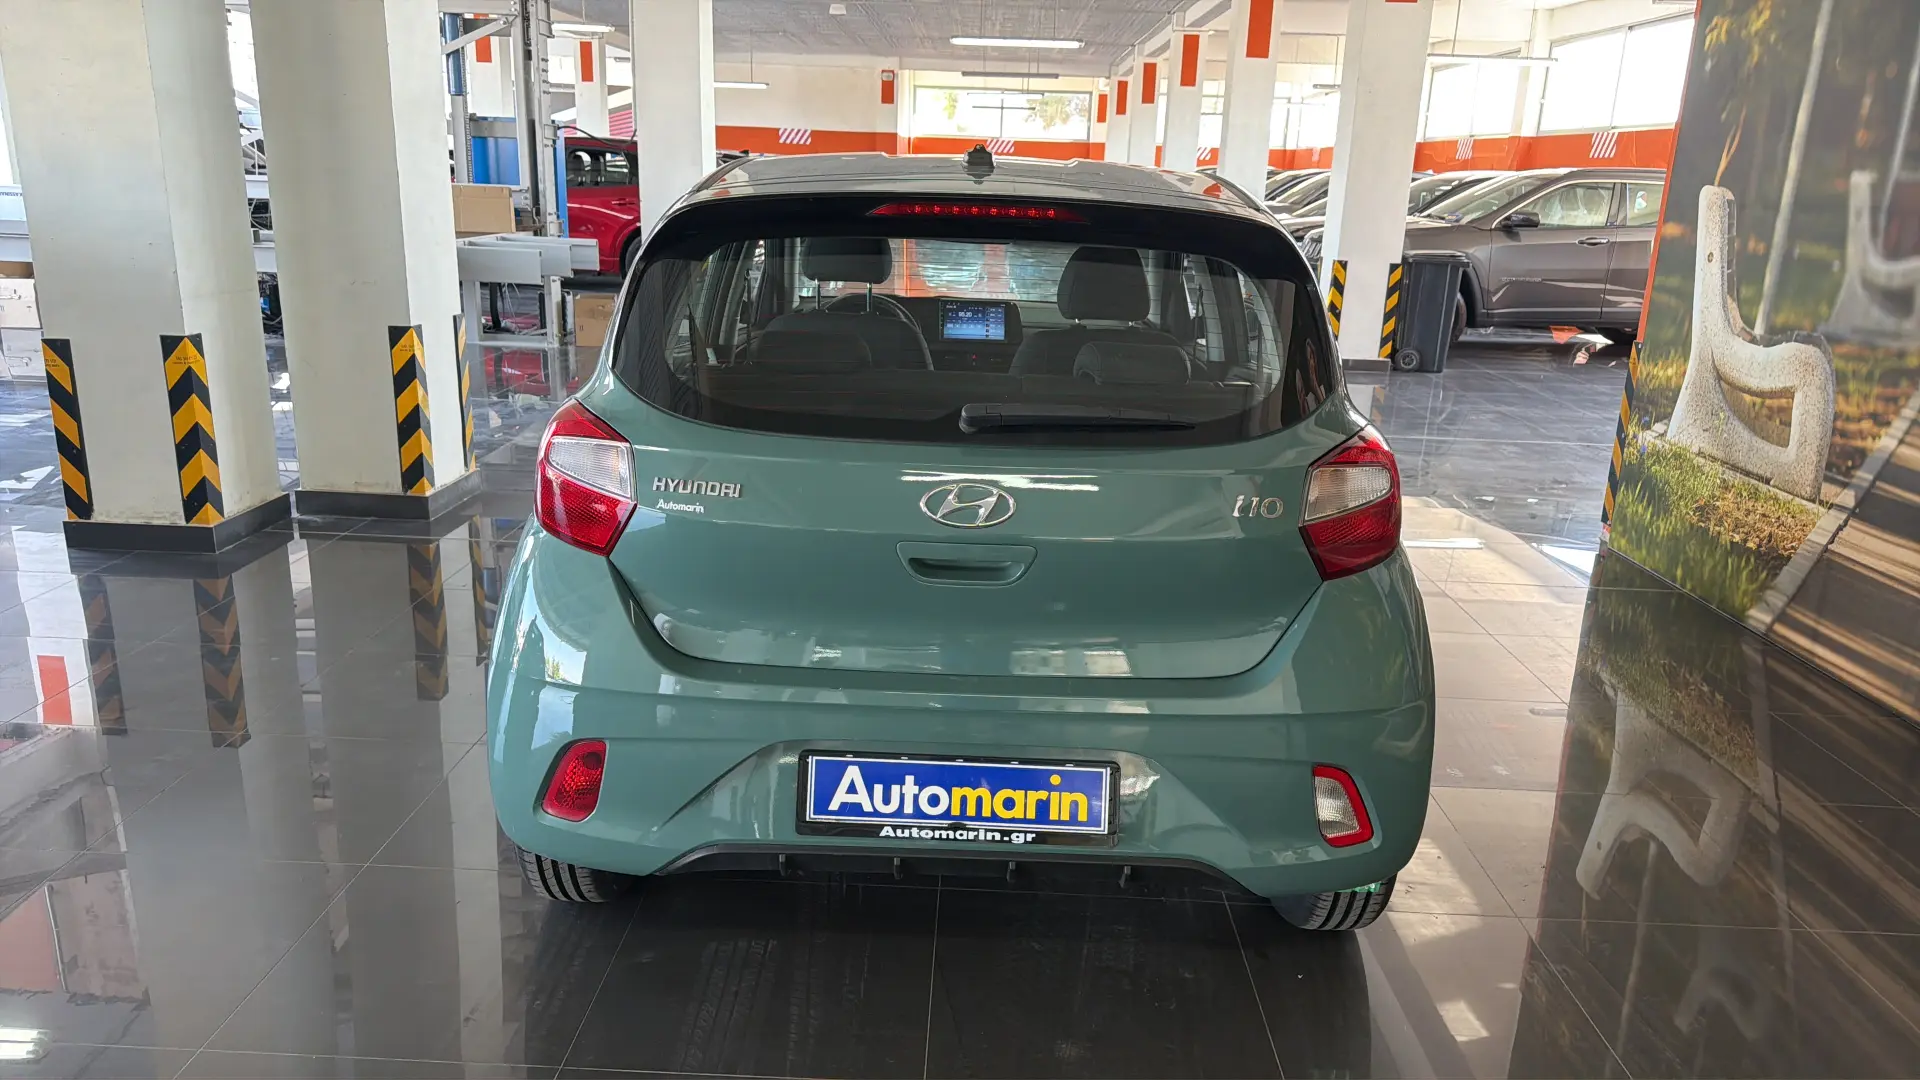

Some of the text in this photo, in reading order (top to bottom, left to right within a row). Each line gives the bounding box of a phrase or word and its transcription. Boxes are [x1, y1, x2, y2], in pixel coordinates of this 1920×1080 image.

[652, 477, 741, 498] HYUNDAI
[656, 499, 705, 514] Automarin
[1232, 495, 1284, 518] i10
[827, 765, 1088, 822] Automarin
[879, 826, 1036, 843] Automarin.gr
